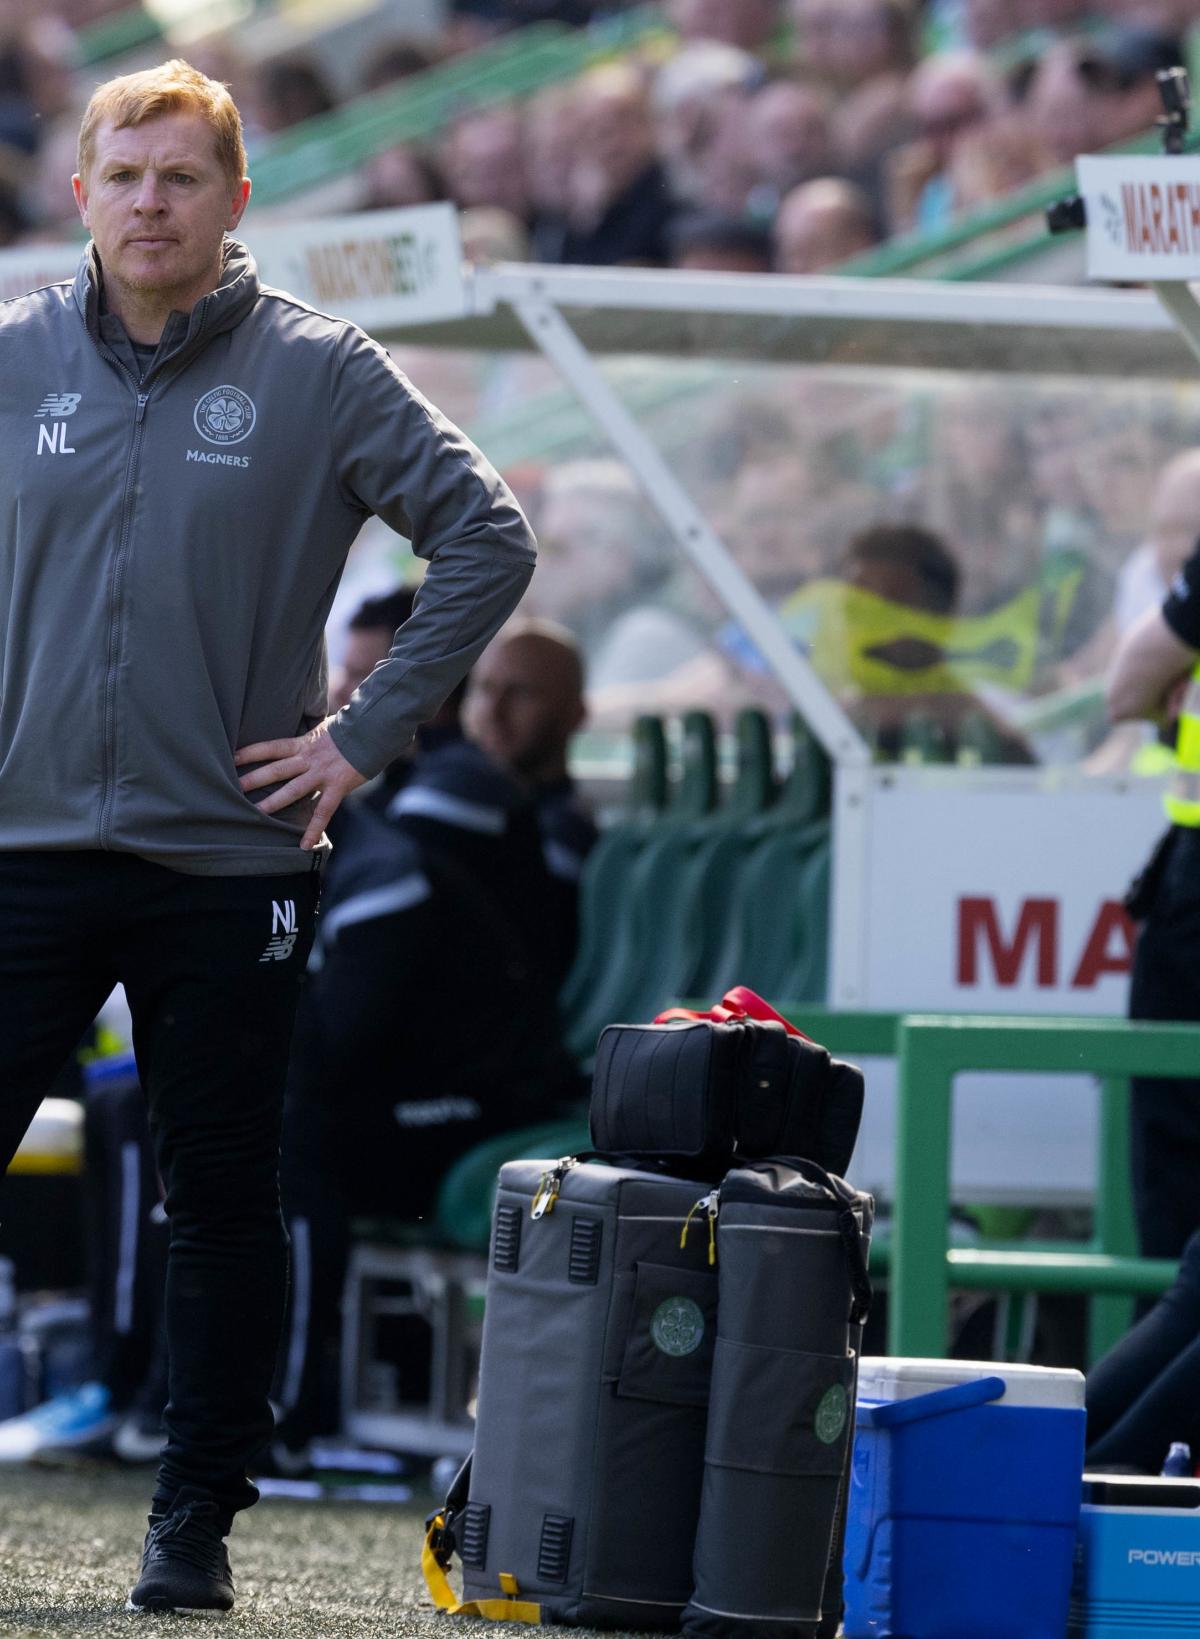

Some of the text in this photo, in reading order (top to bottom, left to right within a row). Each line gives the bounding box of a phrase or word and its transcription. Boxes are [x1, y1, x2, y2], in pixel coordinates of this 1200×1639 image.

[37, 421, 76, 456] NL
[186, 449, 250, 468] MAGNERS
[271, 899, 299, 935] NL
